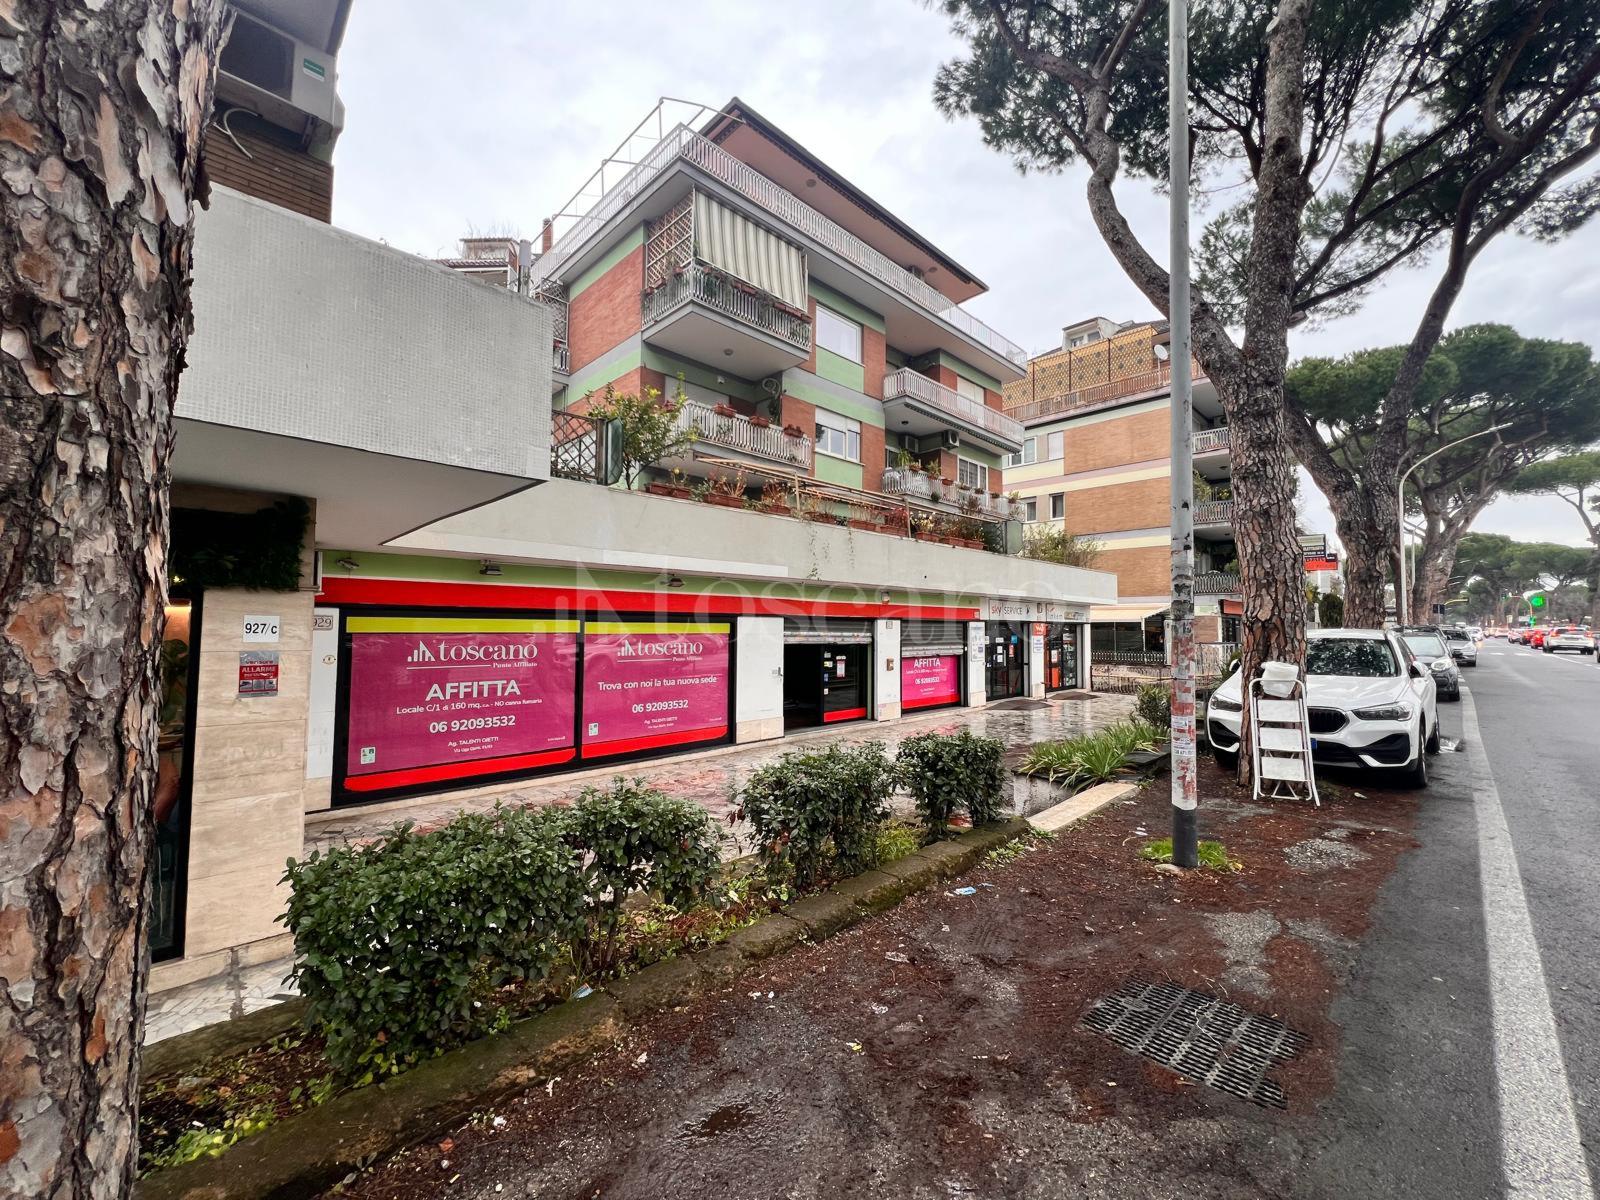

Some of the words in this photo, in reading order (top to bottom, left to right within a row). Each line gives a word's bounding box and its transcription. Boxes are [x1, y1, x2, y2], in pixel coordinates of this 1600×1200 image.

[1004, 606, 1023, 615] SERVICE
[438, 641, 538, 662] toscano
[638, 640, 703, 656] toscano
[914, 658, 941, 668] AFFITTA
[425, 679, 521, 701] AFFITTA
[598, 682, 622, 691] Trova
[624, 681, 638, 689] con
[640, 679, 653, 688] noi
[663, 678, 676, 686] tua
[677, 677, 700, 685] nuova
[700, 675, 718, 683] sede
[396, 706, 425, 714] Locale
[426, 704, 441, 712] C/1
[450, 702, 467, 710] 160
[632, 703, 644, 713] 06
[646, 699, 689, 712] 92093532
[429, 721, 448, 733] 06
[451, 715, 516, 731] 92093532
